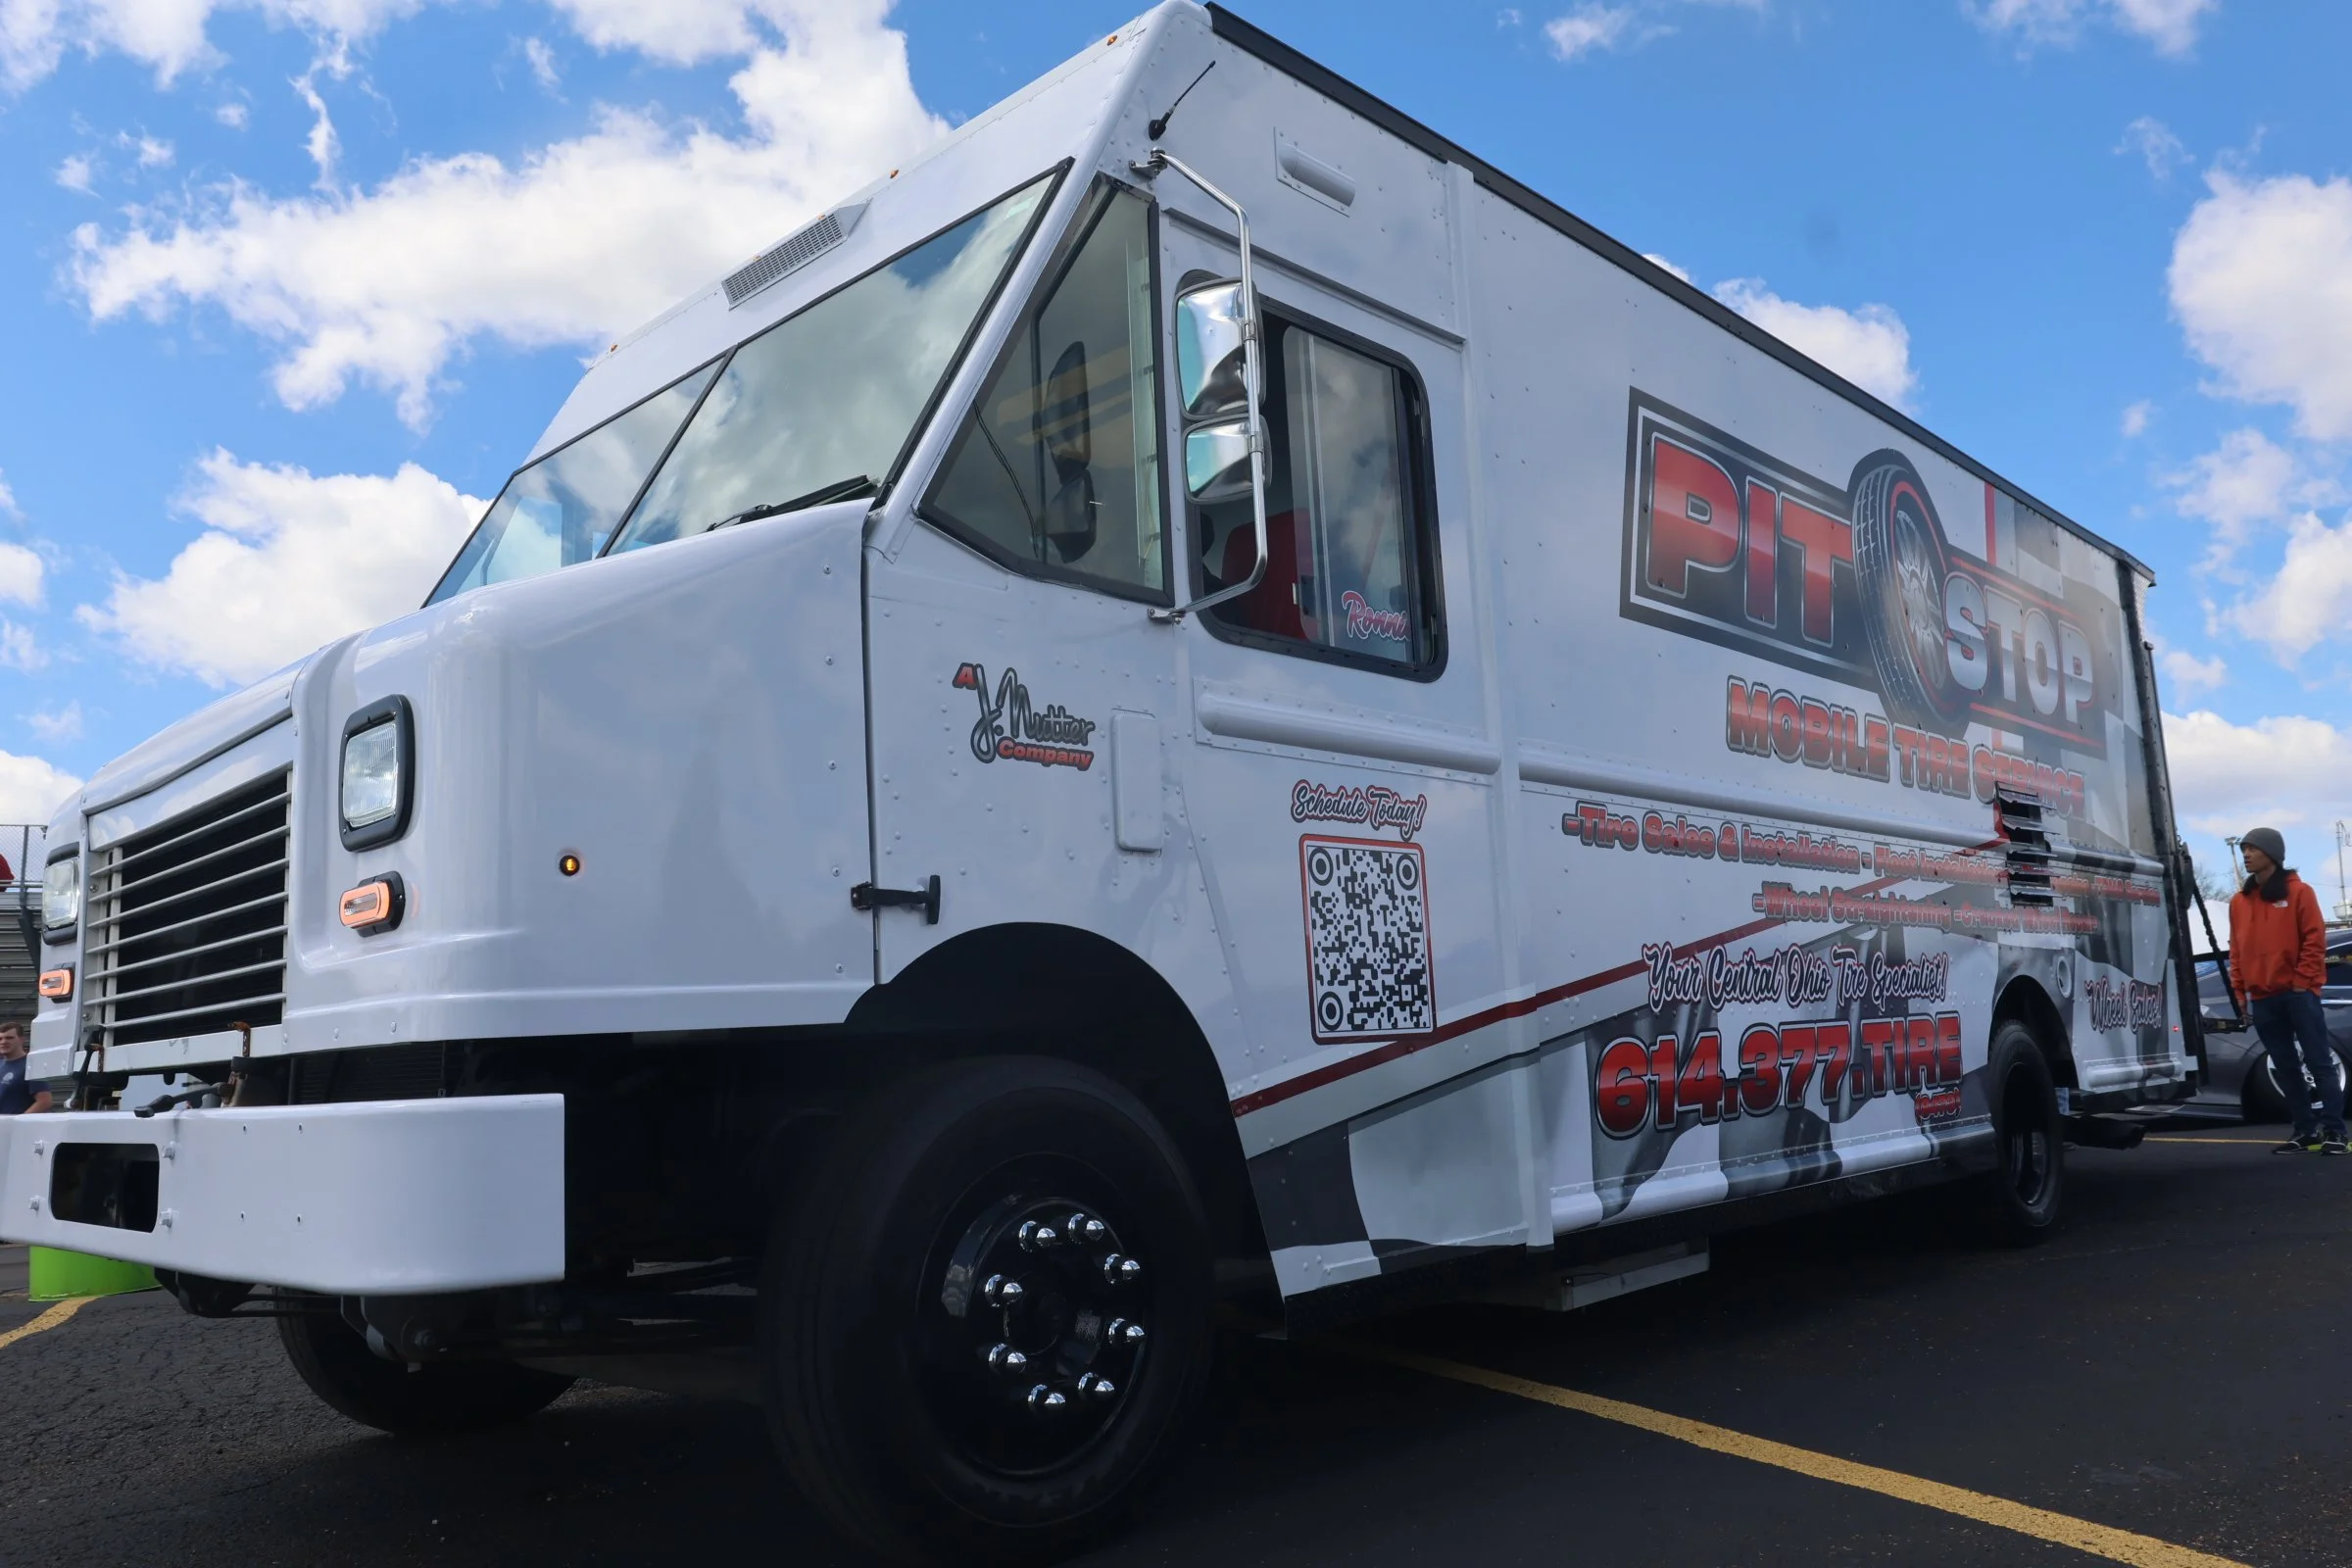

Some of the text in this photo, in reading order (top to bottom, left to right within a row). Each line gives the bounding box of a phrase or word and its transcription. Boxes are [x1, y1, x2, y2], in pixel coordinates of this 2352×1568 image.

[1646, 432, 1853, 647] PIT
[1342, 590, 1411, 641] Ronni
[1943, 572, 2094, 724] STOP
[952, 662, 978, 690] A
[996, 736, 1095, 771] Company
[1727, 674, 2085, 819] MOBILE TIRE SERVICE
[1291, 779, 1427, 842] Schedule Today!
[1642, 810, 1715, 859] Sales
[1717, 821, 1740, 862] &
[1741, 824, 1861, 874] Installation
[1919, 848, 2007, 888] Installation
[1831, 886, 1952, 933] Straightening
[1642, 941, 1948, 1013] Your Central Ohio Tire Specialist!
[2084, 975, 2128, 1034] Wheel
[1596, 1010, 1963, 1140] 614.377.TIRE
